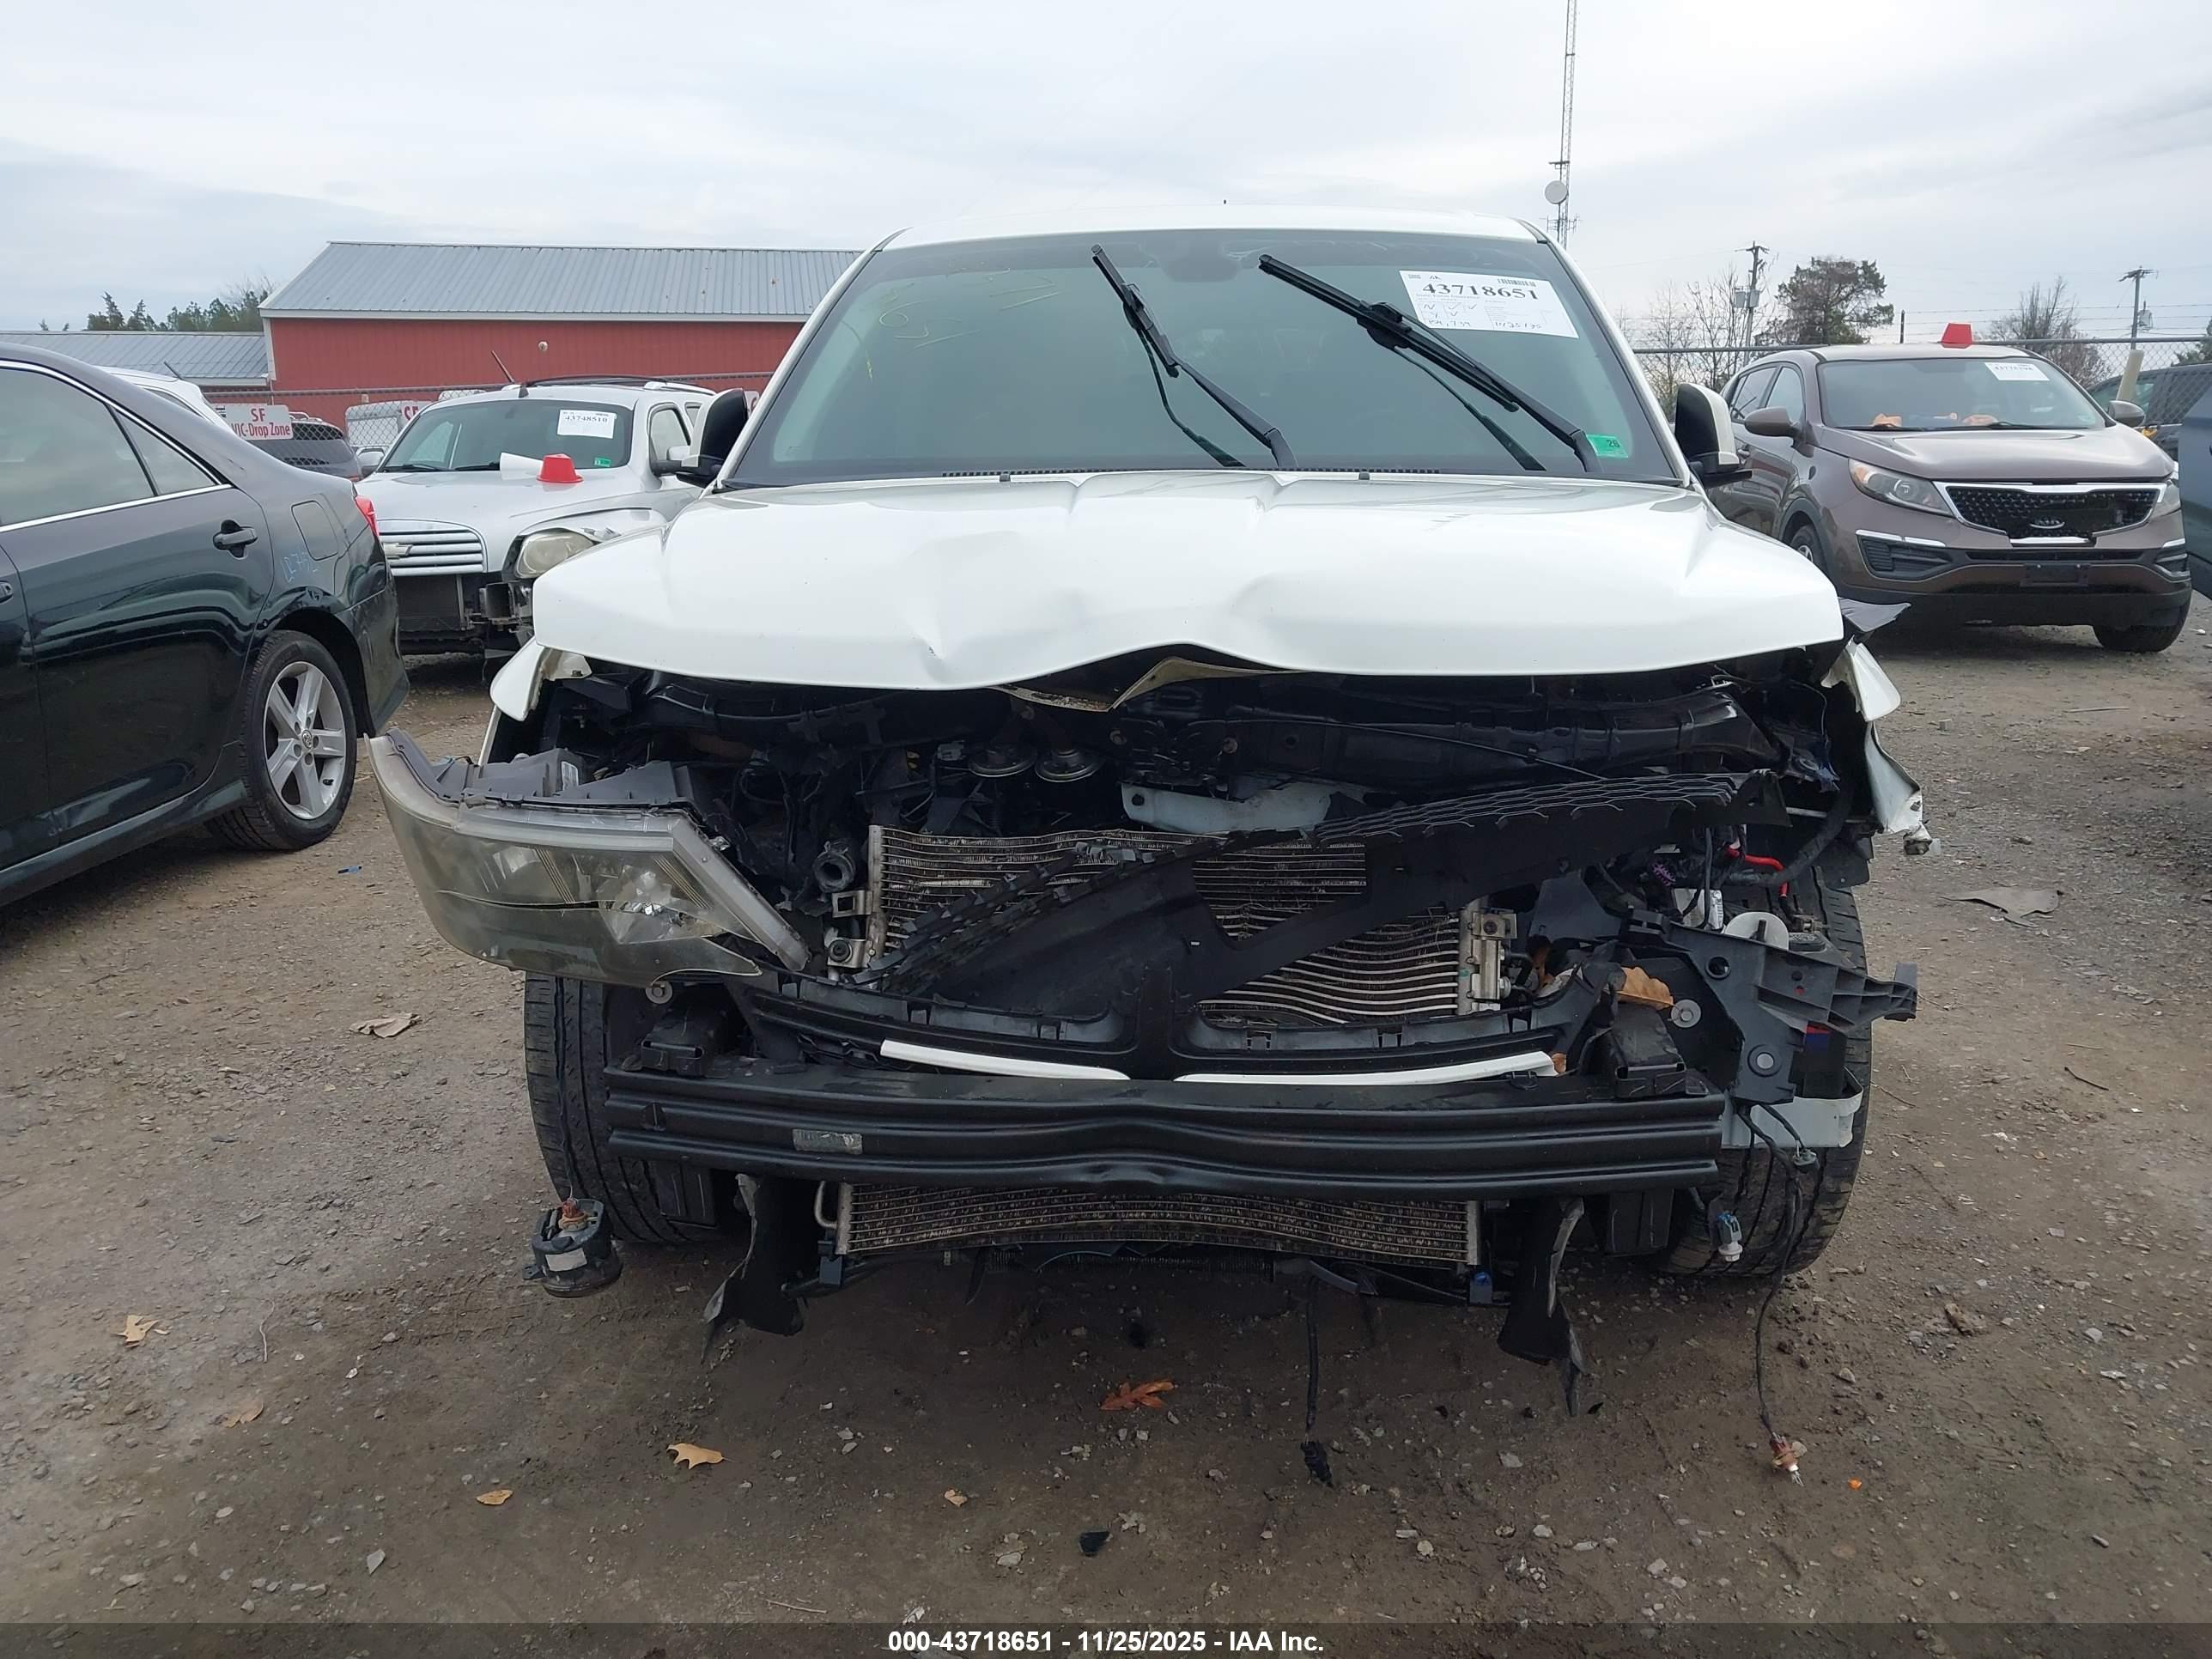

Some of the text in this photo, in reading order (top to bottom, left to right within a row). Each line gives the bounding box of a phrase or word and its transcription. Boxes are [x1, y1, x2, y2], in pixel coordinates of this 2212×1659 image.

[1422, 283, 1539, 301] 43718651
[251, 408, 266, 422] SF
[269, 422, 290, 436] Zone
